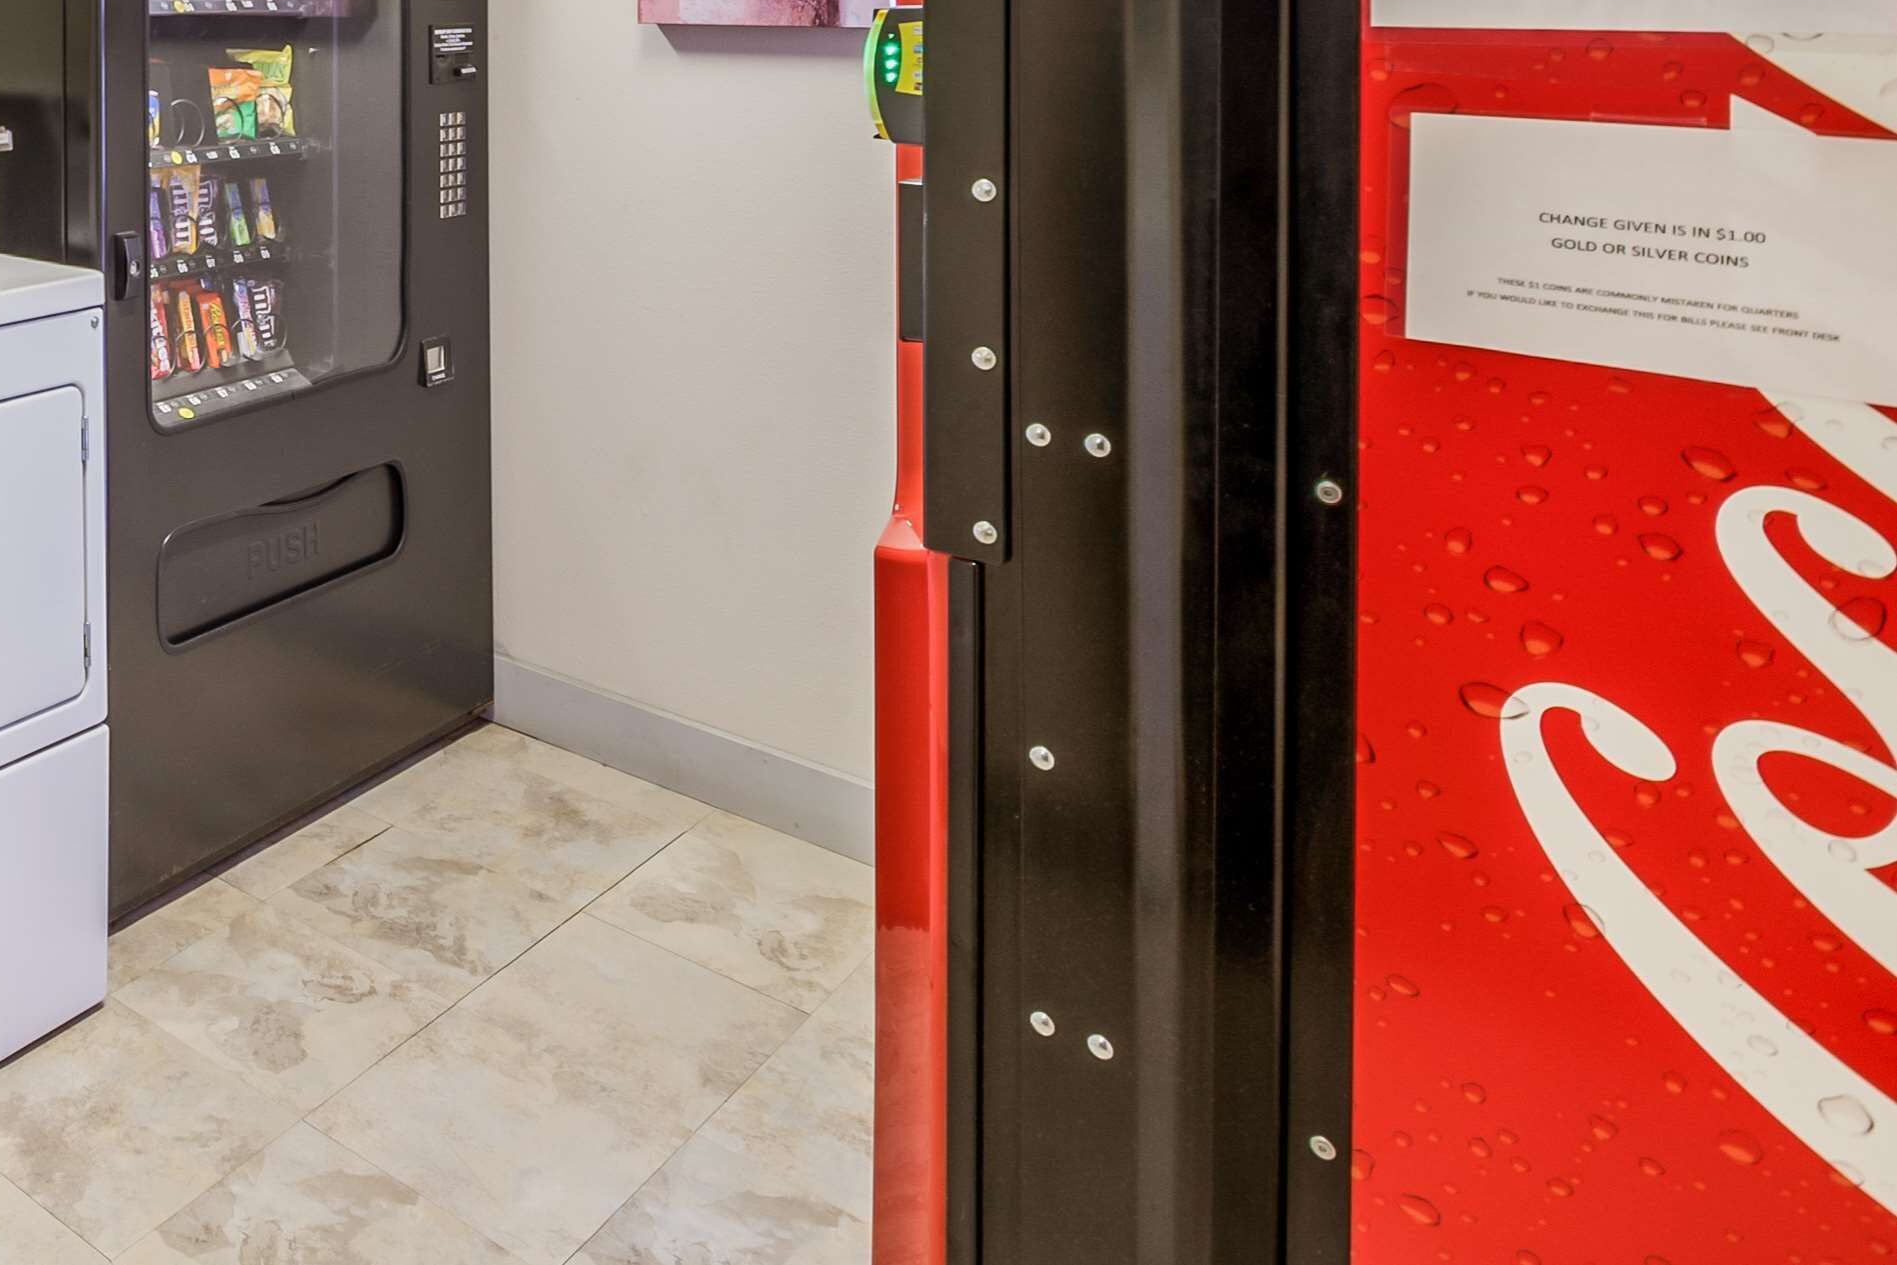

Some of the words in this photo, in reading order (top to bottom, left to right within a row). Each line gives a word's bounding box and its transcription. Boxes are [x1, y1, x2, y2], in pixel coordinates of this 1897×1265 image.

[1539, 212, 1608, 229] CHANGE
[1614, 219, 1666, 234] GIVEN
[1672, 225, 1687, 236] IS
[1692, 227, 1711, 239] IN
[1716, 228, 1766, 244] $1.00
[1551, 238, 1597, 252] GOLD
[1602, 243, 1626, 255] OR
[1631, 245, 1688, 262] SILVER
[1694, 252, 1749, 268] COINS
[1478, 291, 1497, 300] YOU
[1499, 294, 1536, 305] WOULD
[1538, 299, 1557, 308] LIKE
[1561, 302, 1573, 310] TO
[1576, 303, 1629, 317] EXCHANGE
[1633, 310, 1655, 320] THIS
[1657, 313, 1678, 322] FOR
[1681, 316, 1707, 327] BILLS
[1709, 319, 1747, 331] PLEASE
[1750, 324, 1768, 333] SEE
[1772, 327, 1809, 338] FRONT
[1812, 332, 1840, 342] DESK
[1497, 277, 1525, 287] THESE
[1543, 283, 1572, 293] COINS
[1575, 287, 1594, 296] ARE
[1596, 288, 1659, 303] COMMONLY
[1661, 296, 1714, 309] MISTAKEN
[1717, 303, 1738, 312] FOR
[1741, 305, 1799, 320] QUARTERS
